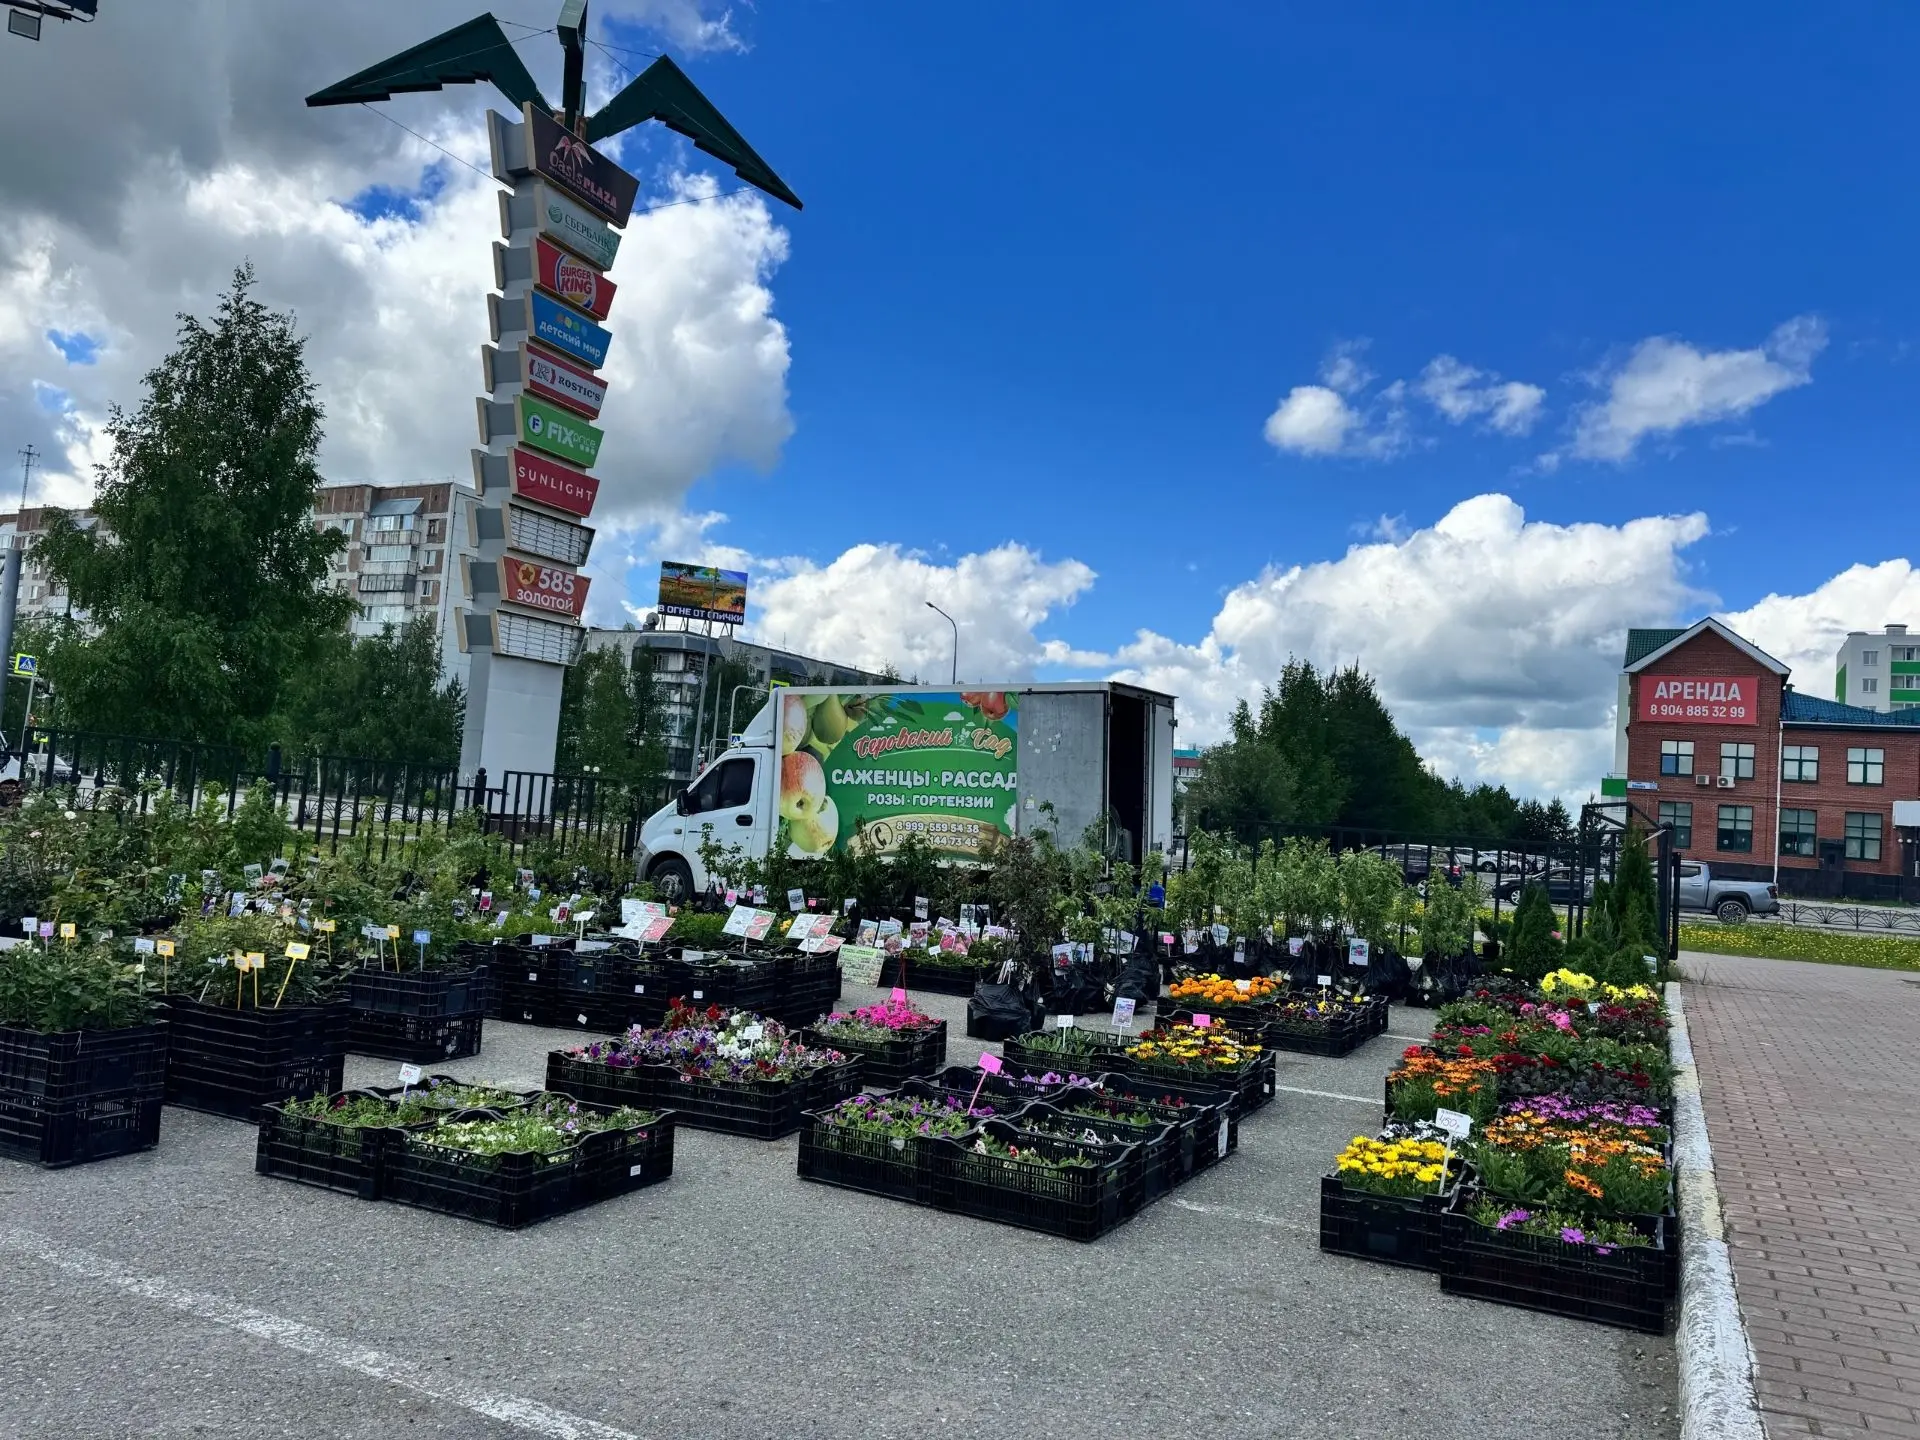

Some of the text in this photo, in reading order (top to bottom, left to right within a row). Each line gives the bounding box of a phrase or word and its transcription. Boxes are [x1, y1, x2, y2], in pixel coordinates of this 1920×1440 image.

[564, 213, 611, 251] СБЕРБАНК
[560, 265, 592, 281] BURGER
[560, 277, 593, 295] KING
[583, 342, 601, 359] мир
[558, 375, 601, 402] ROSTIC'S
[518, 466, 593, 501] SUNLIGHT
[538, 567, 575, 595] 585
[516, 588, 574, 613] ЗОЛОТОЙ
[658, 604, 665, 612] В
[666, 605, 692, 616] ОГНЕ
[693, 609, 706, 618] ОТ
[1654, 681, 1742, 702] АРЕНДА
[1650, 704, 1745, 718] 8 904 885 32 99
[853, 726, 1013, 760] Серовский Сад
[831, 768, 931, 788] САЖЕНЦЫ
[867, 793, 994, 809] РОЗЫ ГОРТЕНЗИИ
[896, 821, 980, 834] 8 999 559 54 38
[896, 834, 904, 844] 8
[929, 835, 947, 846] 144
[949, 836, 962, 846] 73
